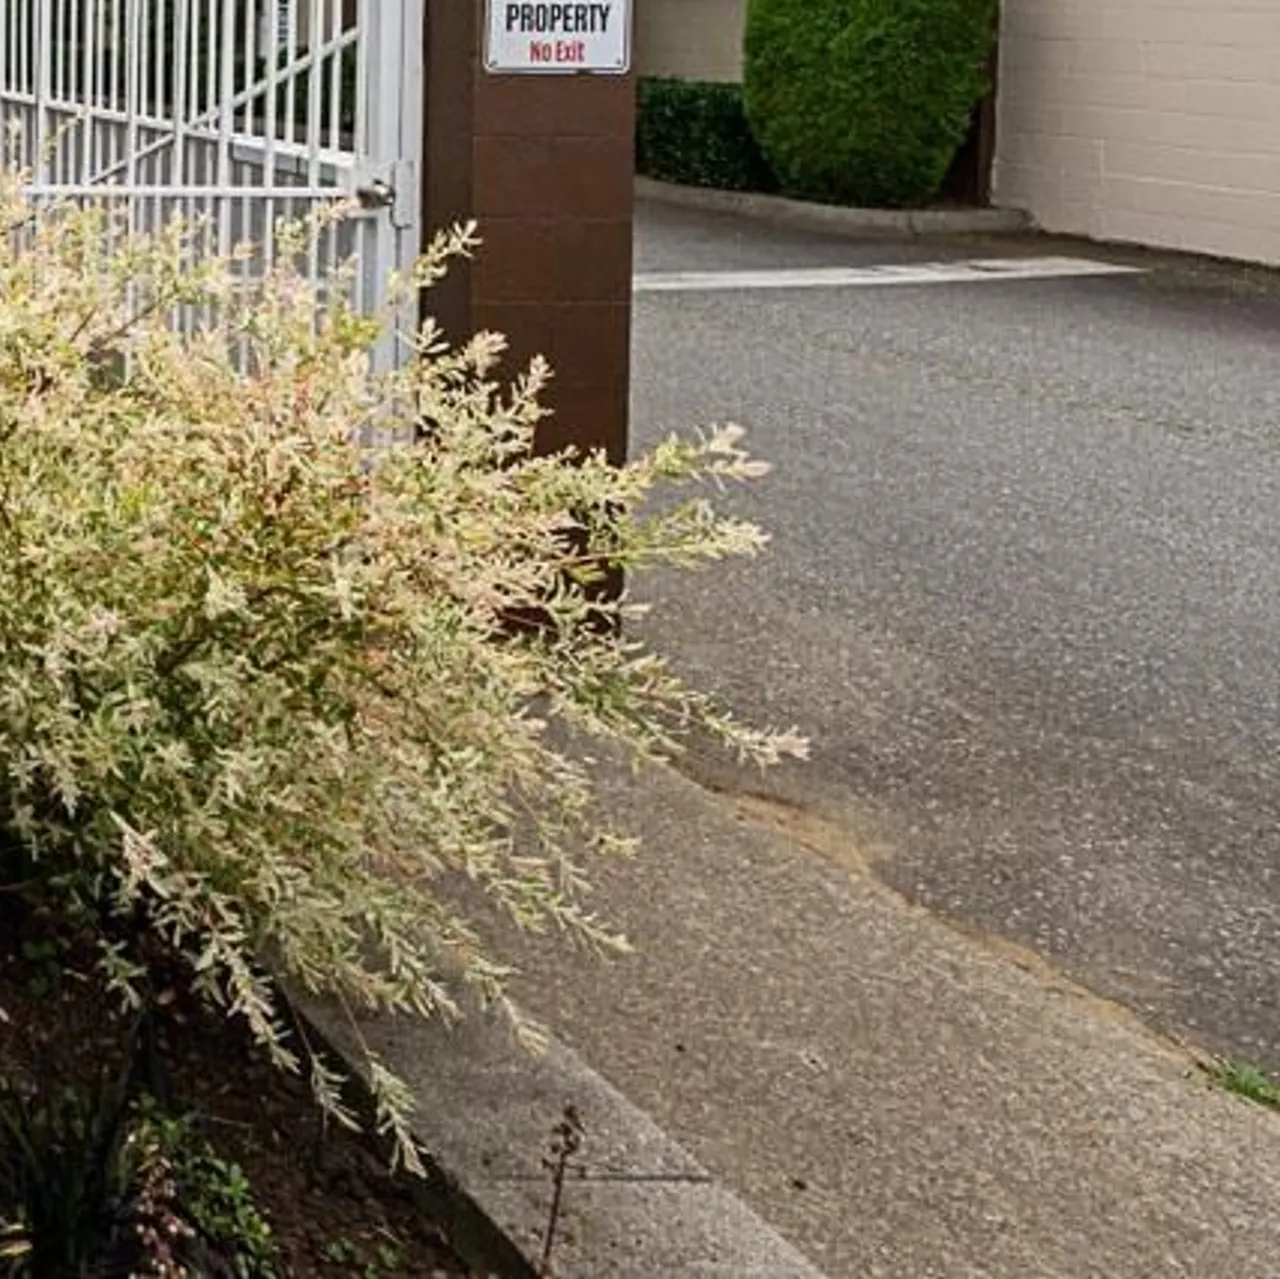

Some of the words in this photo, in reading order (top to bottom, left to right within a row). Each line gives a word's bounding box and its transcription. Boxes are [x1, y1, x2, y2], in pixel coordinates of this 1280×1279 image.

[506, 4, 611, 32] PROPERTY
[529, 40, 552, 62] No
[554, 40, 585, 62] Exit
